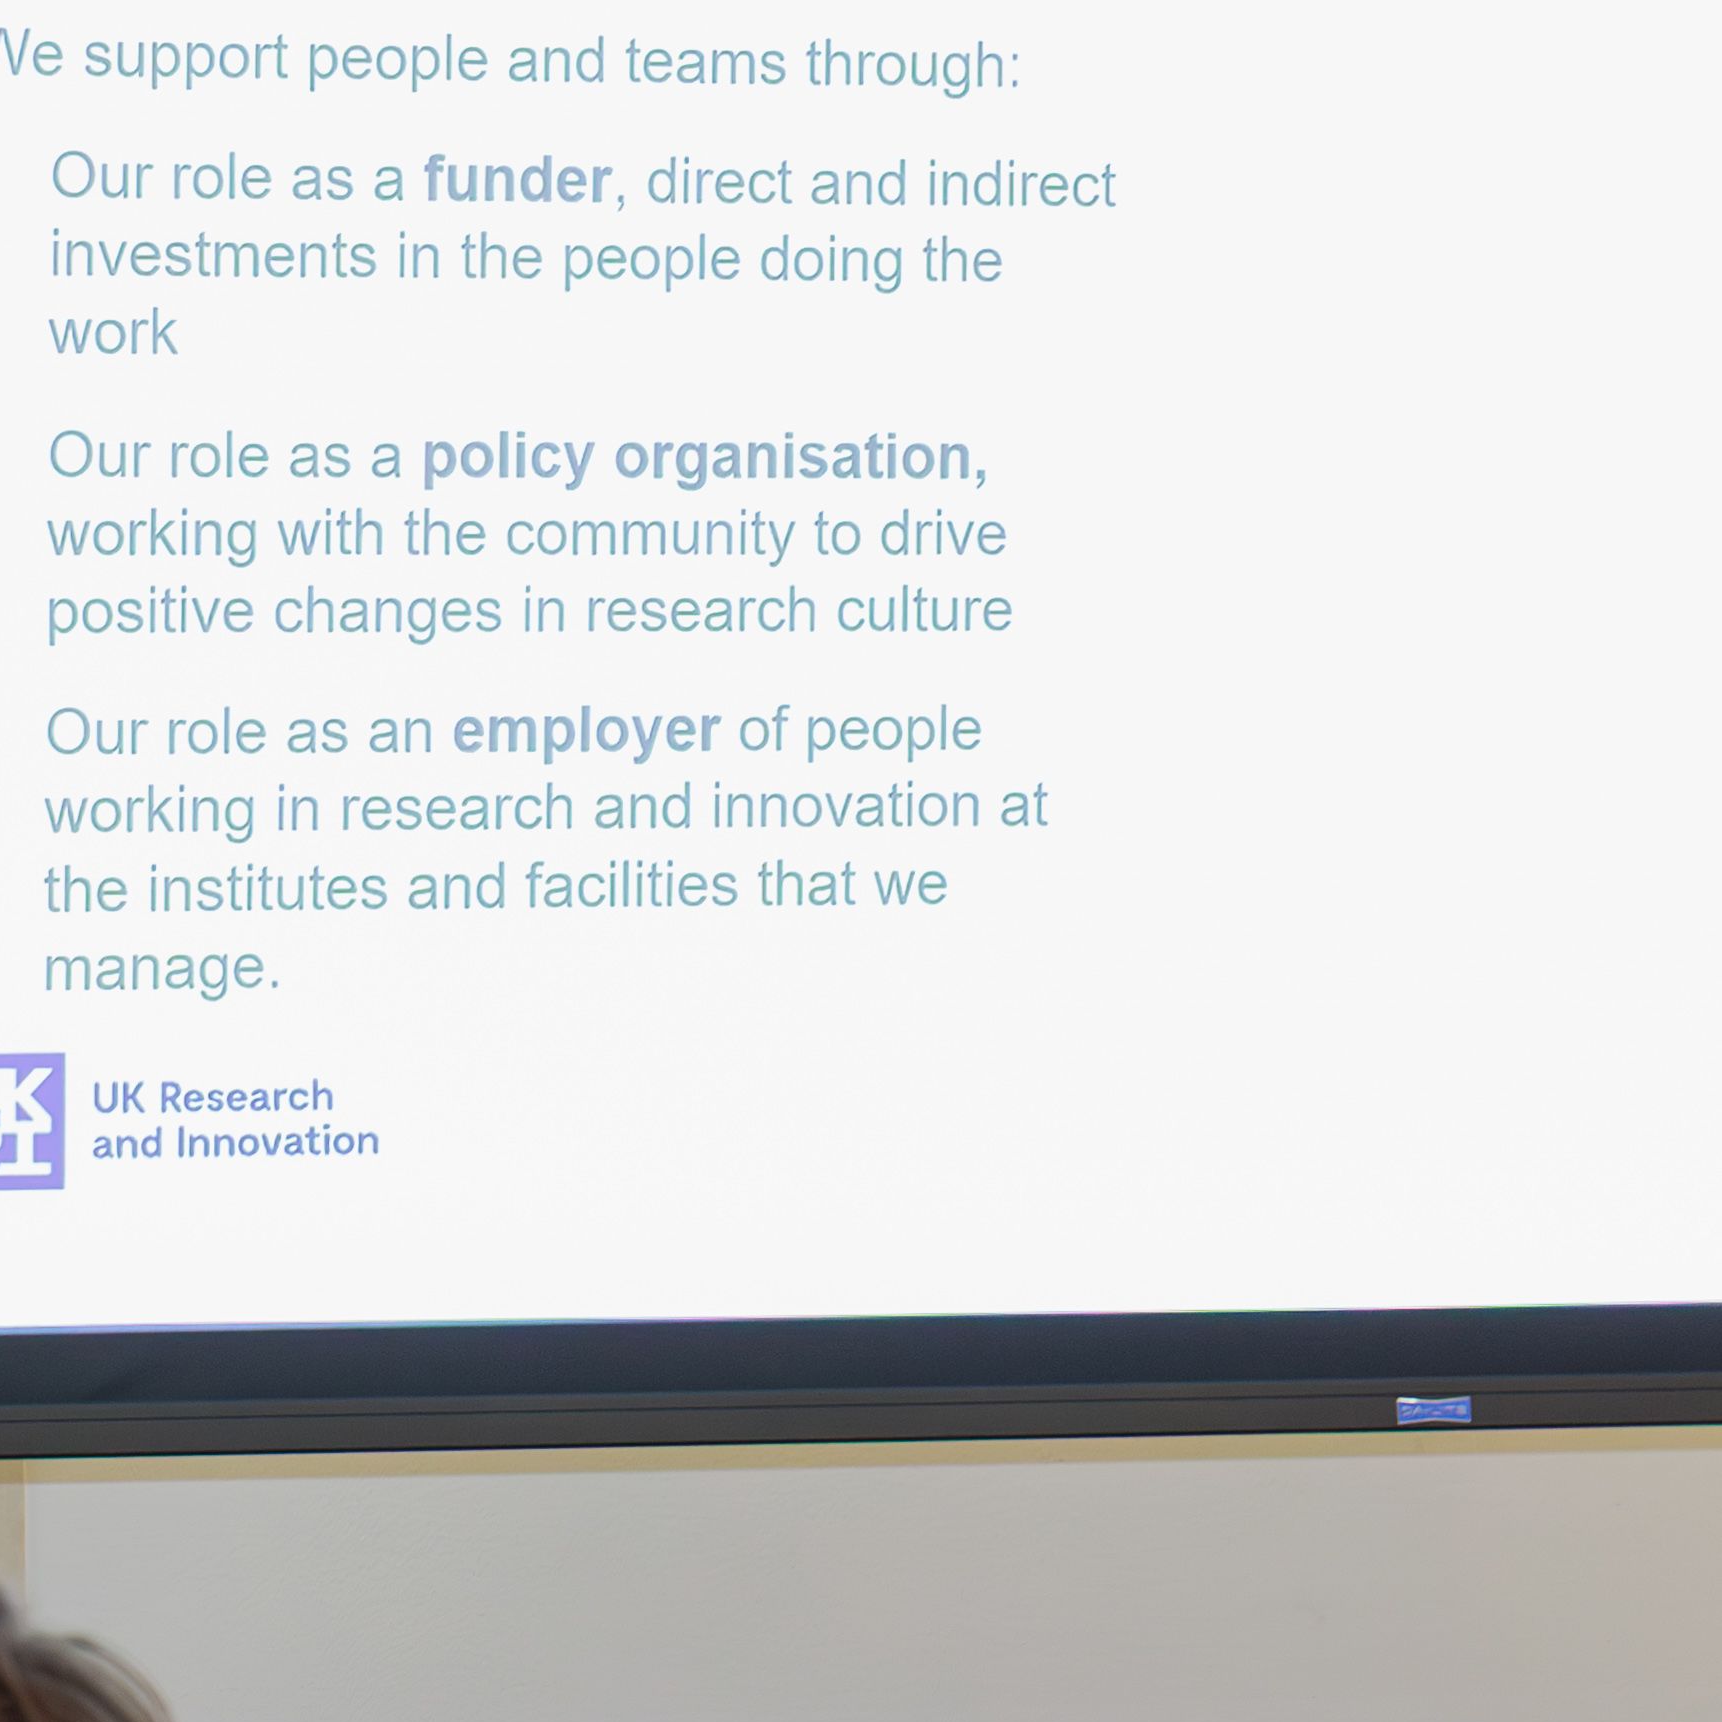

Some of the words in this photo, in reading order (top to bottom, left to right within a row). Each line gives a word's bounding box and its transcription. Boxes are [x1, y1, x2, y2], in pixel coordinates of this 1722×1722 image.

[84, 33, 289, 91] support
[308, 32, 489, 94] people
[508, 34, 605, 84] and
[624, 37, 787, 86] teams
[805, 37, 1019, 100] through:
[51, 149, 155, 200] Our
[173, 150, 273, 201] role
[291, 164, 355, 202] as
[373, 165, 404, 202] a
[423, 152, 625, 213] funder,
[647, 155, 794, 205] direct
[810, 158, 907, 207] and
[928, 158, 1117, 209] indirect
[52, 227, 378, 279] investments
[398, 229, 440, 279] in
[460, 230, 543, 280] the
[563, 232, 741, 293] people
[759, 233, 903, 293] doing
[922, 234, 1003, 283] the
[47, 305, 179, 356] work
[49, 429, 153, 479] Our
[170, 429, 270, 479] role
[288, 442, 352, 479] as
[370, 442, 402, 479] a
[423, 430, 596, 492] policy
[614, 431, 987, 492] organisation,
[46, 506, 257, 569] working
[276, 506, 384, 557] with
[403, 506, 487, 557] the
[506, 507, 797, 569] community
[813, 510, 862, 557] to
[880, 507, 1007, 557] drive
[48, 584, 255, 648] positive
[274, 584, 503, 646] changes
[523, 584, 565, 633] in
[587, 583, 816, 633] research
[836, 583, 1013, 633] culture
[46, 706, 150, 756] Our
[167, 705, 267, 756] role
[286, 717, 349, 755] as
[368, 716, 432, 754] an
[453, 704, 723, 766] employer
[738, 703, 792, 753] of
[806, 703, 983, 764] people
[43, 783, 255, 845] working
[277, 782, 319, 832] in
[341, 781, 573, 832] research
[593, 780, 692, 830] and
[713, 779, 980, 829] innovation
[1000, 781, 1049, 828] at
[43, 863, 129, 913] the
[149, 862, 389, 913] institutes
[407, 860, 506, 911] and
[524, 858, 739, 909] facilities
[757, 858, 857, 907] that
[873, 869, 949, 907] we
[45, 952, 279, 1003] manage.
[92, 1080, 146, 1115] UK
[160, 1077, 334, 1115] Research
[92, 1125, 163, 1161] and
[177, 1122, 380, 1159] Innovation
